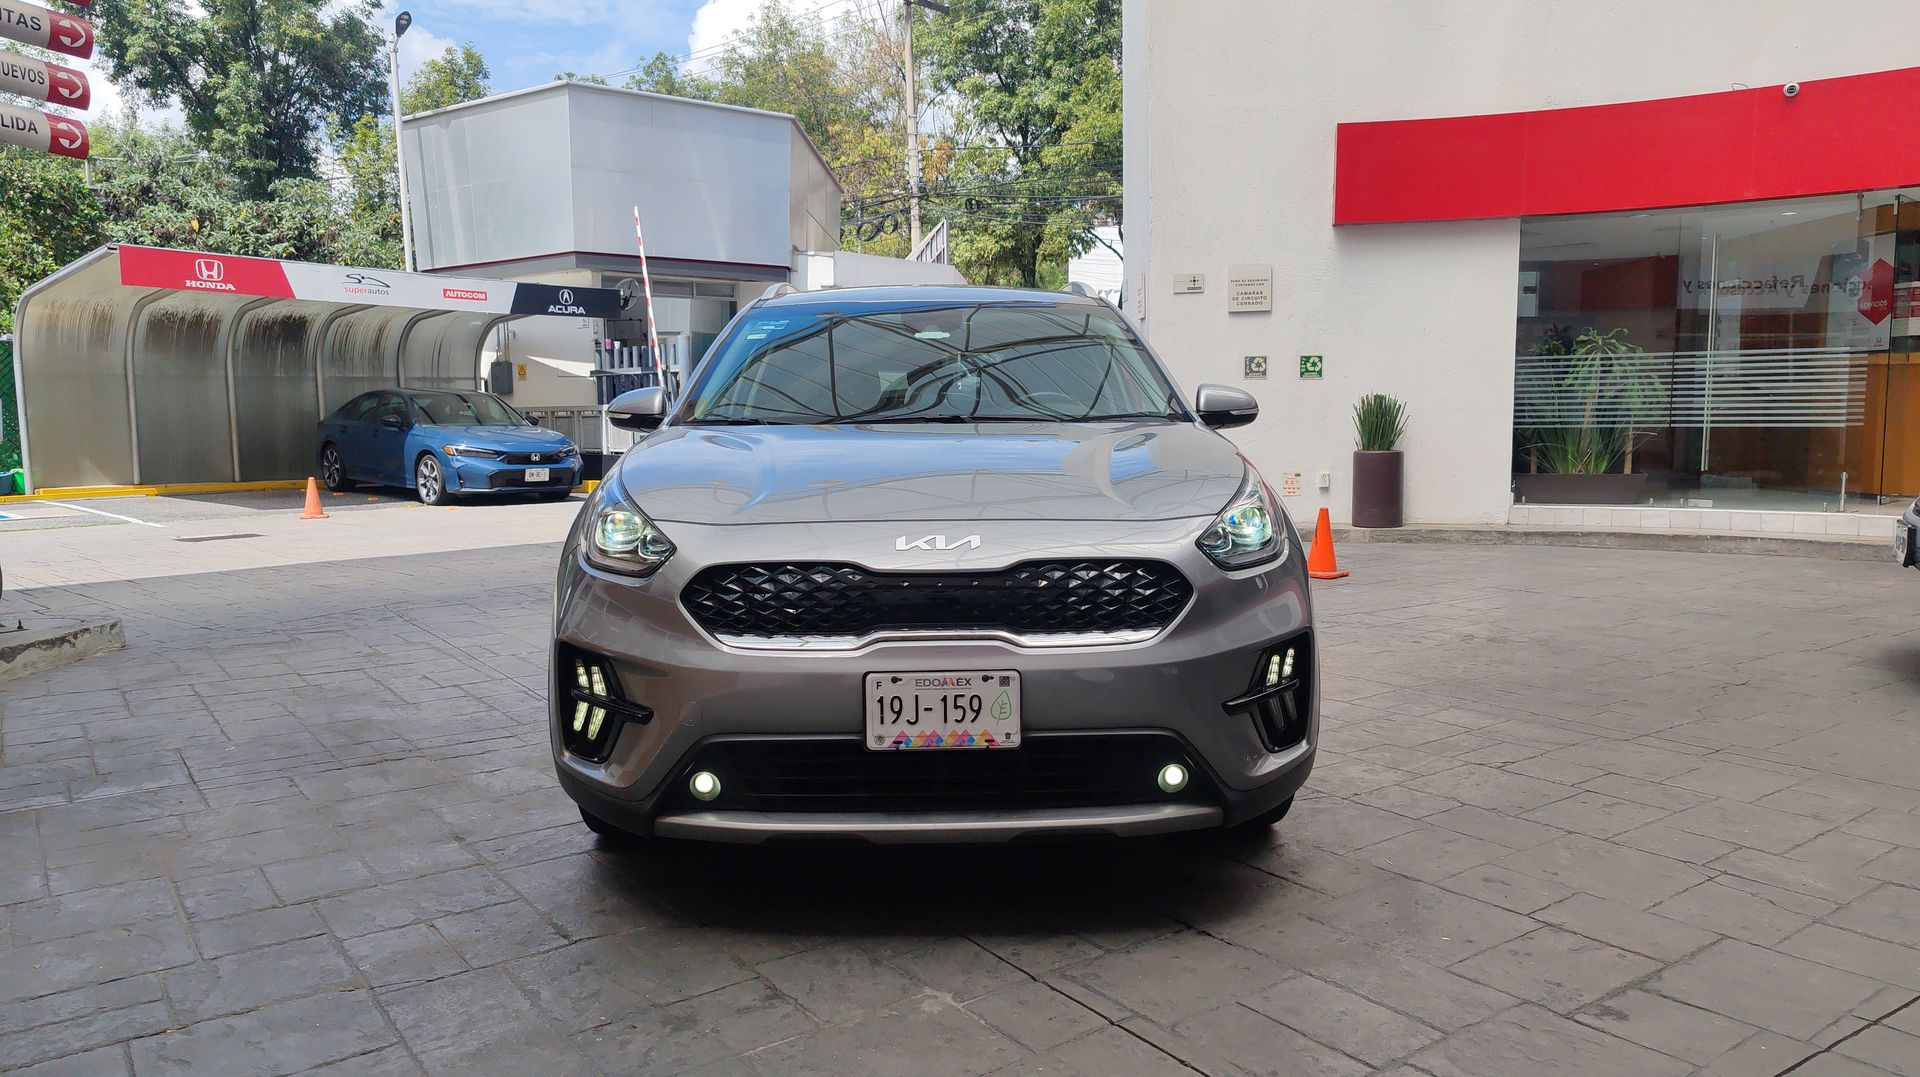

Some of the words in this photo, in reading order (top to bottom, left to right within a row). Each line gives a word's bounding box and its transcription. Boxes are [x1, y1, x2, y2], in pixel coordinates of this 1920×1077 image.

[0, 8, 42, 31] TAS
[185, 280, 237, 291] HONDA
[344, 286, 390, 296] superautos
[445, 290, 486, 300] AUTOCOM
[548, 305, 586, 315] ACURA
[895, 534, 981, 551] KIA
[876, 681, 883, 690] F
[877, 694, 983, 726] 19J-159
